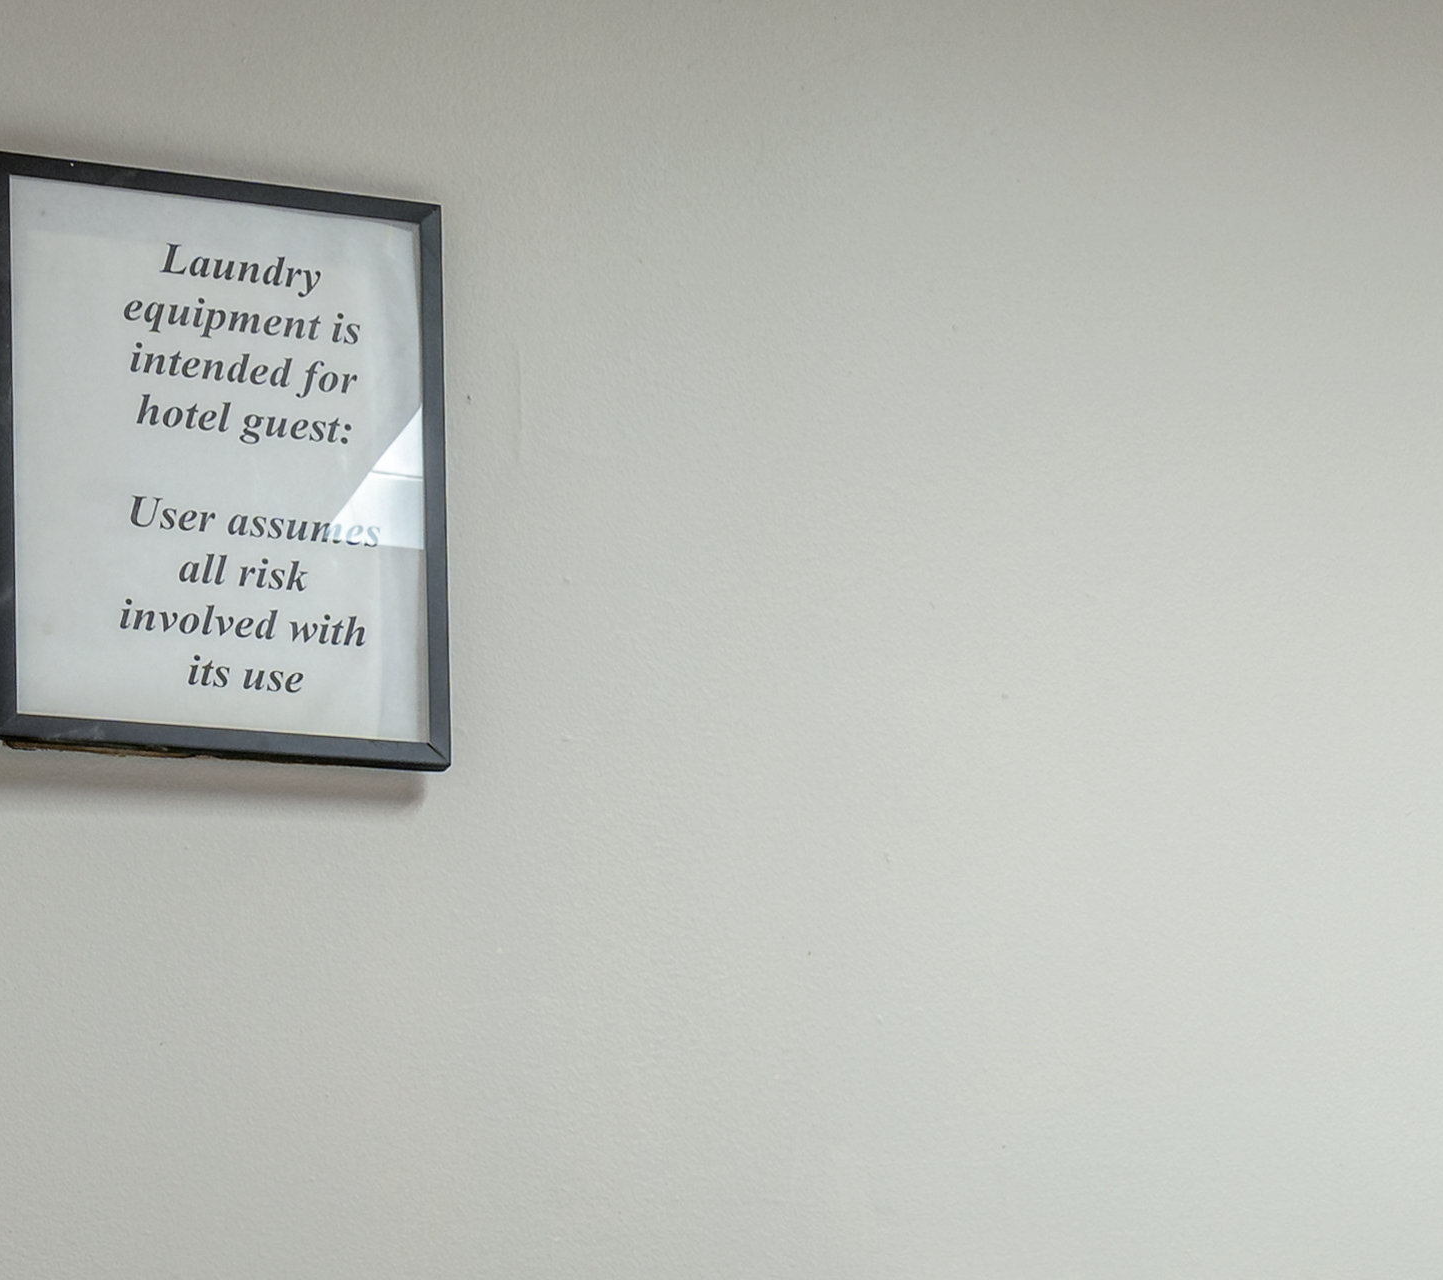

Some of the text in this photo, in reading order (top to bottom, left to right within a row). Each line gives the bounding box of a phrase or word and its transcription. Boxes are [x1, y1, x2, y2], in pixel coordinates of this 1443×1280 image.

[160, 243, 322, 298] Laundry
[123, 298, 361, 346] equipment is
[130, 344, 358, 398] intended for
[135, 395, 353, 446] hotel guest:
[129, 495, 381, 549] User assumes
[178, 554, 309, 592] all risk
[119, 599, 366, 647] involved with
[187, 655, 304, 694] its use
